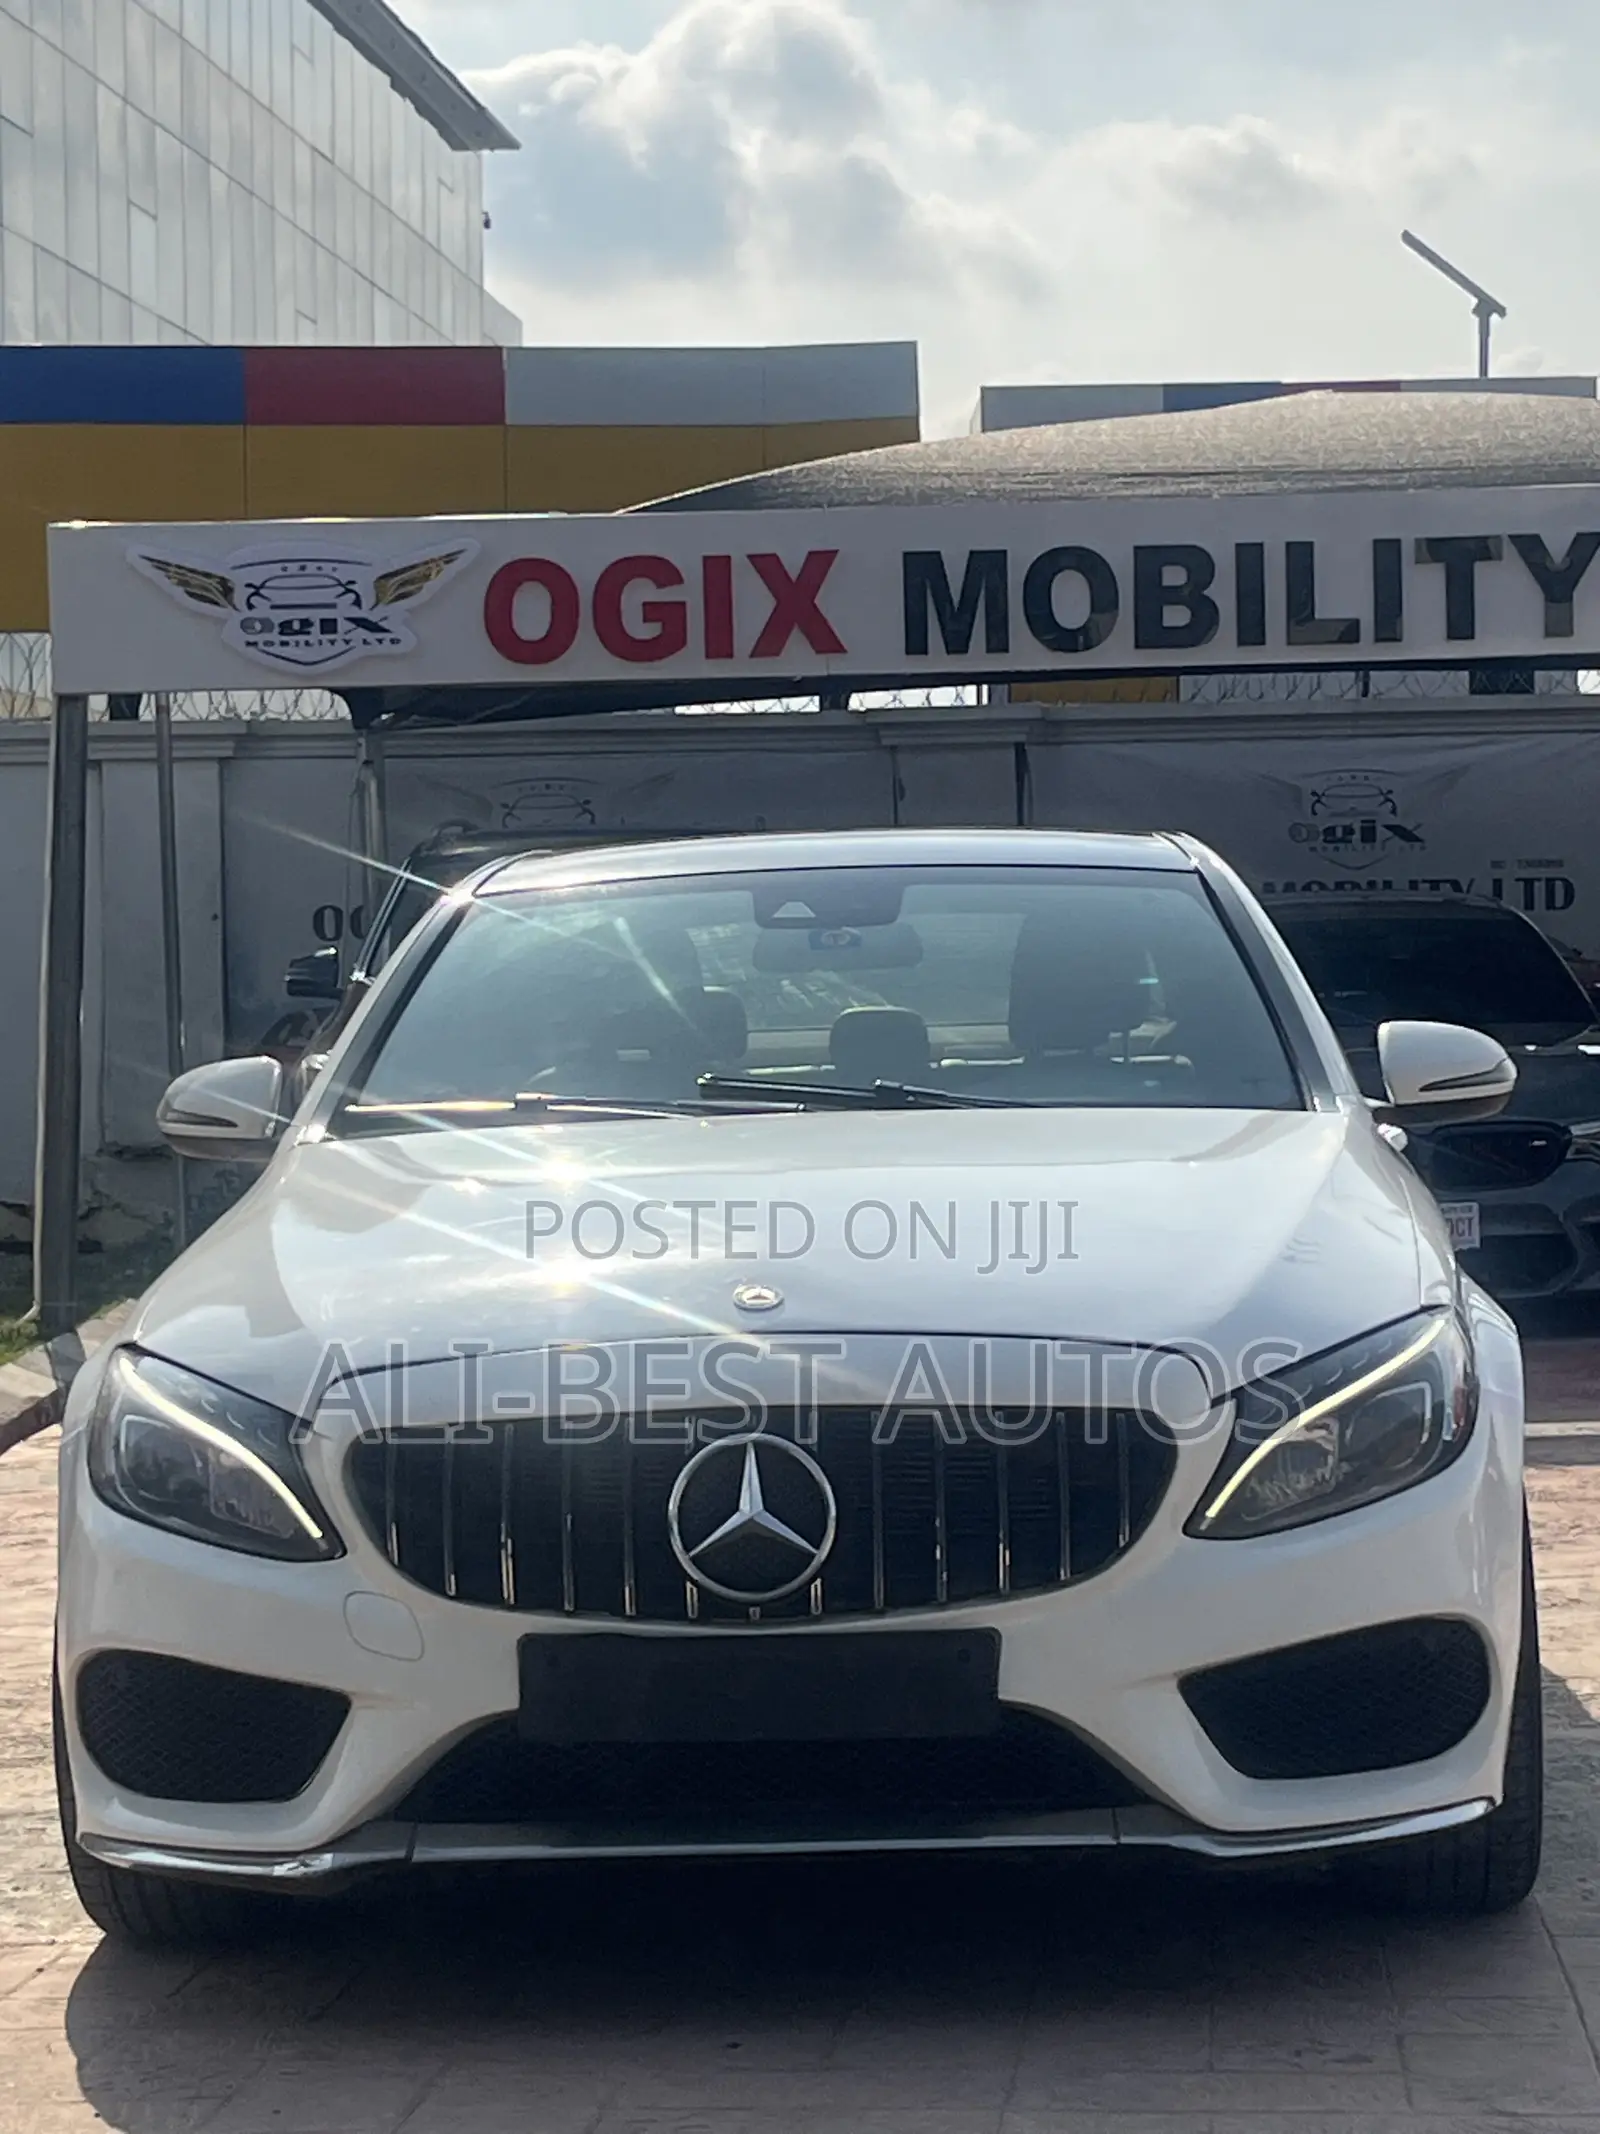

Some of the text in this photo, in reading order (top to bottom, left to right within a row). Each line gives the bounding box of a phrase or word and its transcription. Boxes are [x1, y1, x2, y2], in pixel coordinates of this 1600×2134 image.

[483, 531, 1600, 665] OGIX MOBILITY
[244, 637, 402, 648] MOBILITY LTD
